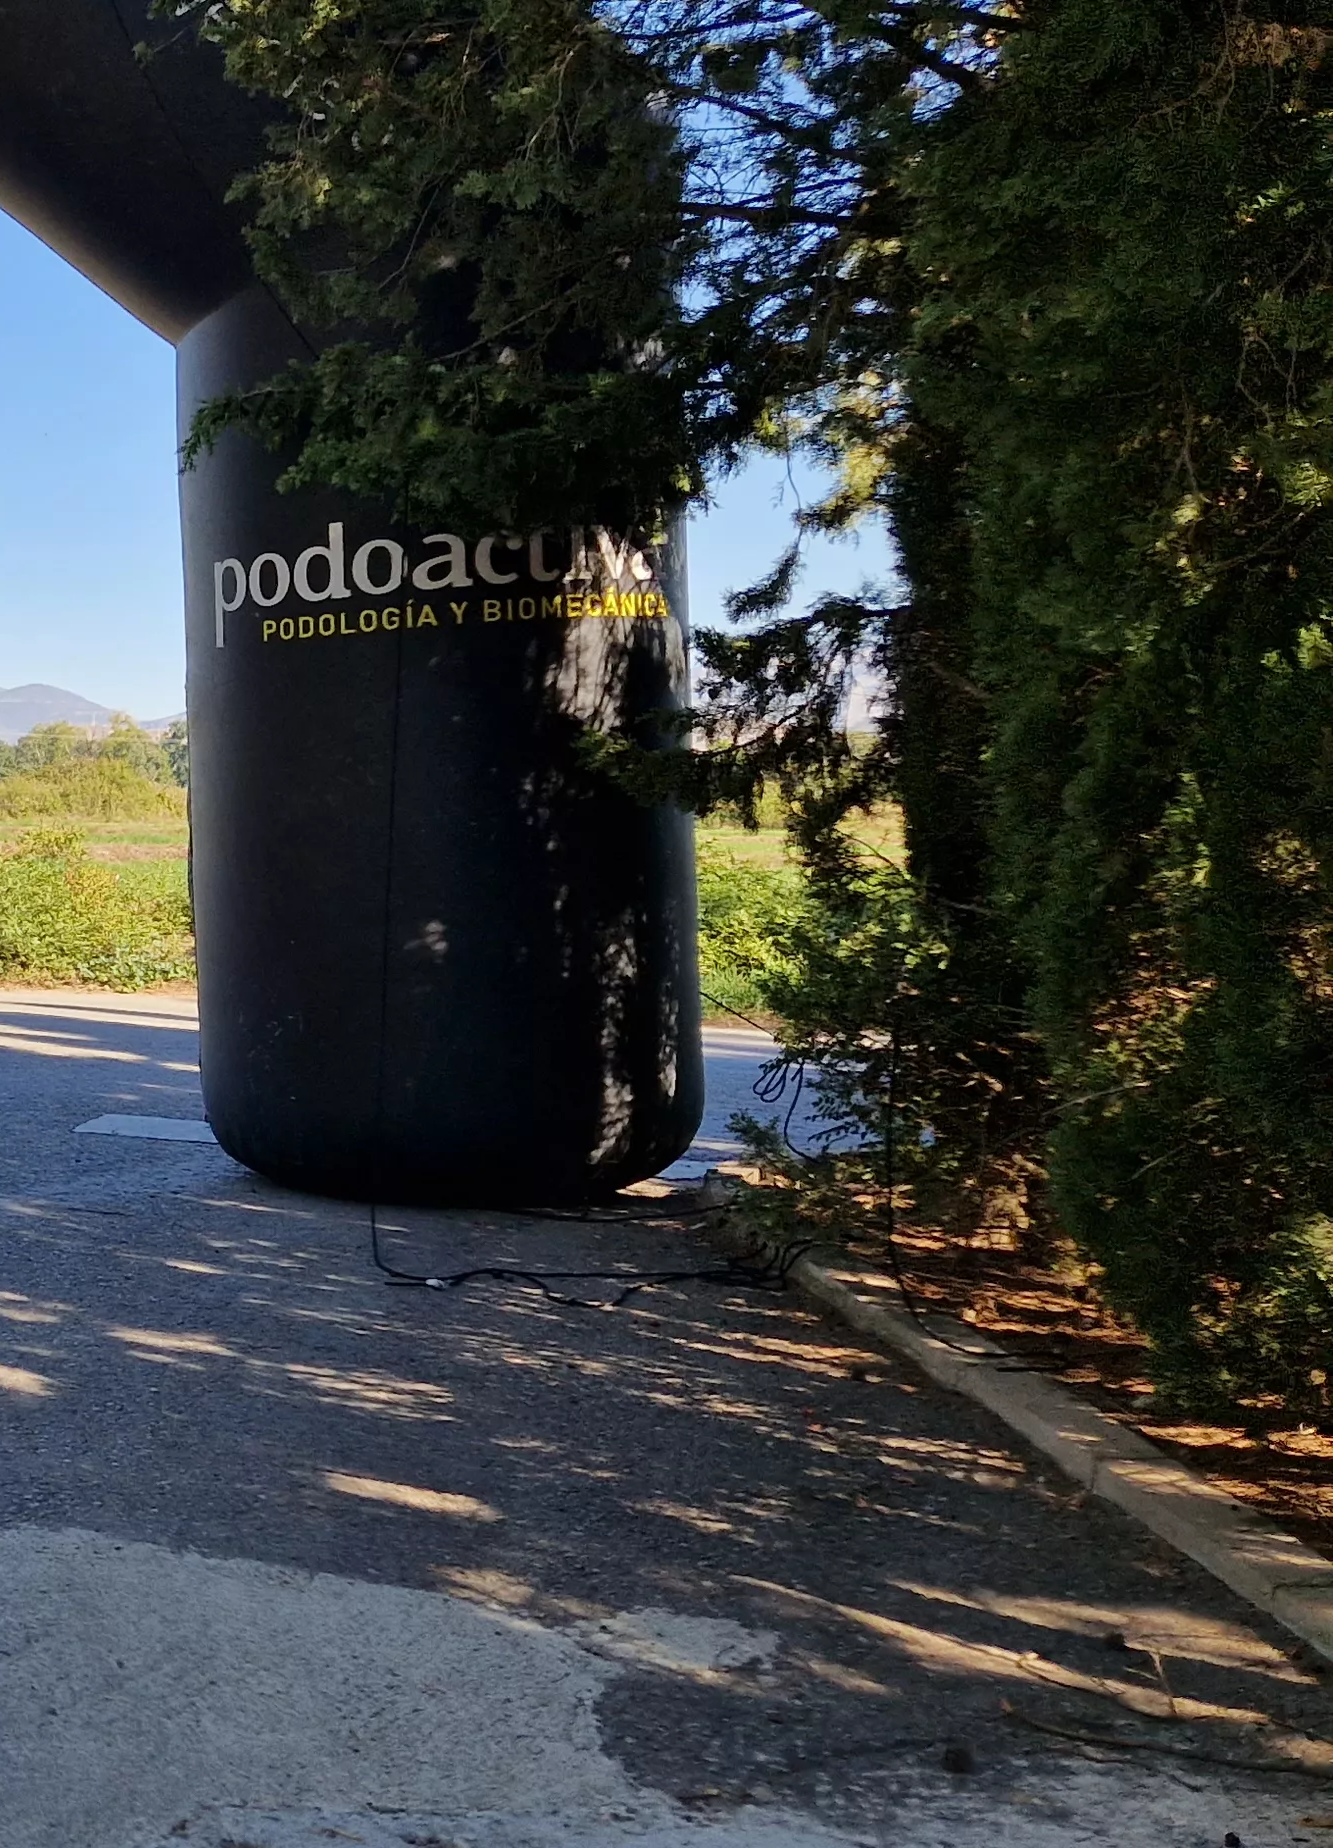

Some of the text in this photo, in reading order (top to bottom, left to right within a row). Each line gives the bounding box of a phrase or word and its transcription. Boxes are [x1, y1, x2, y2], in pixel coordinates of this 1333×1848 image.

[262, 587, 670, 642] PODOLOGÍA Y BIOMECÁNICA
